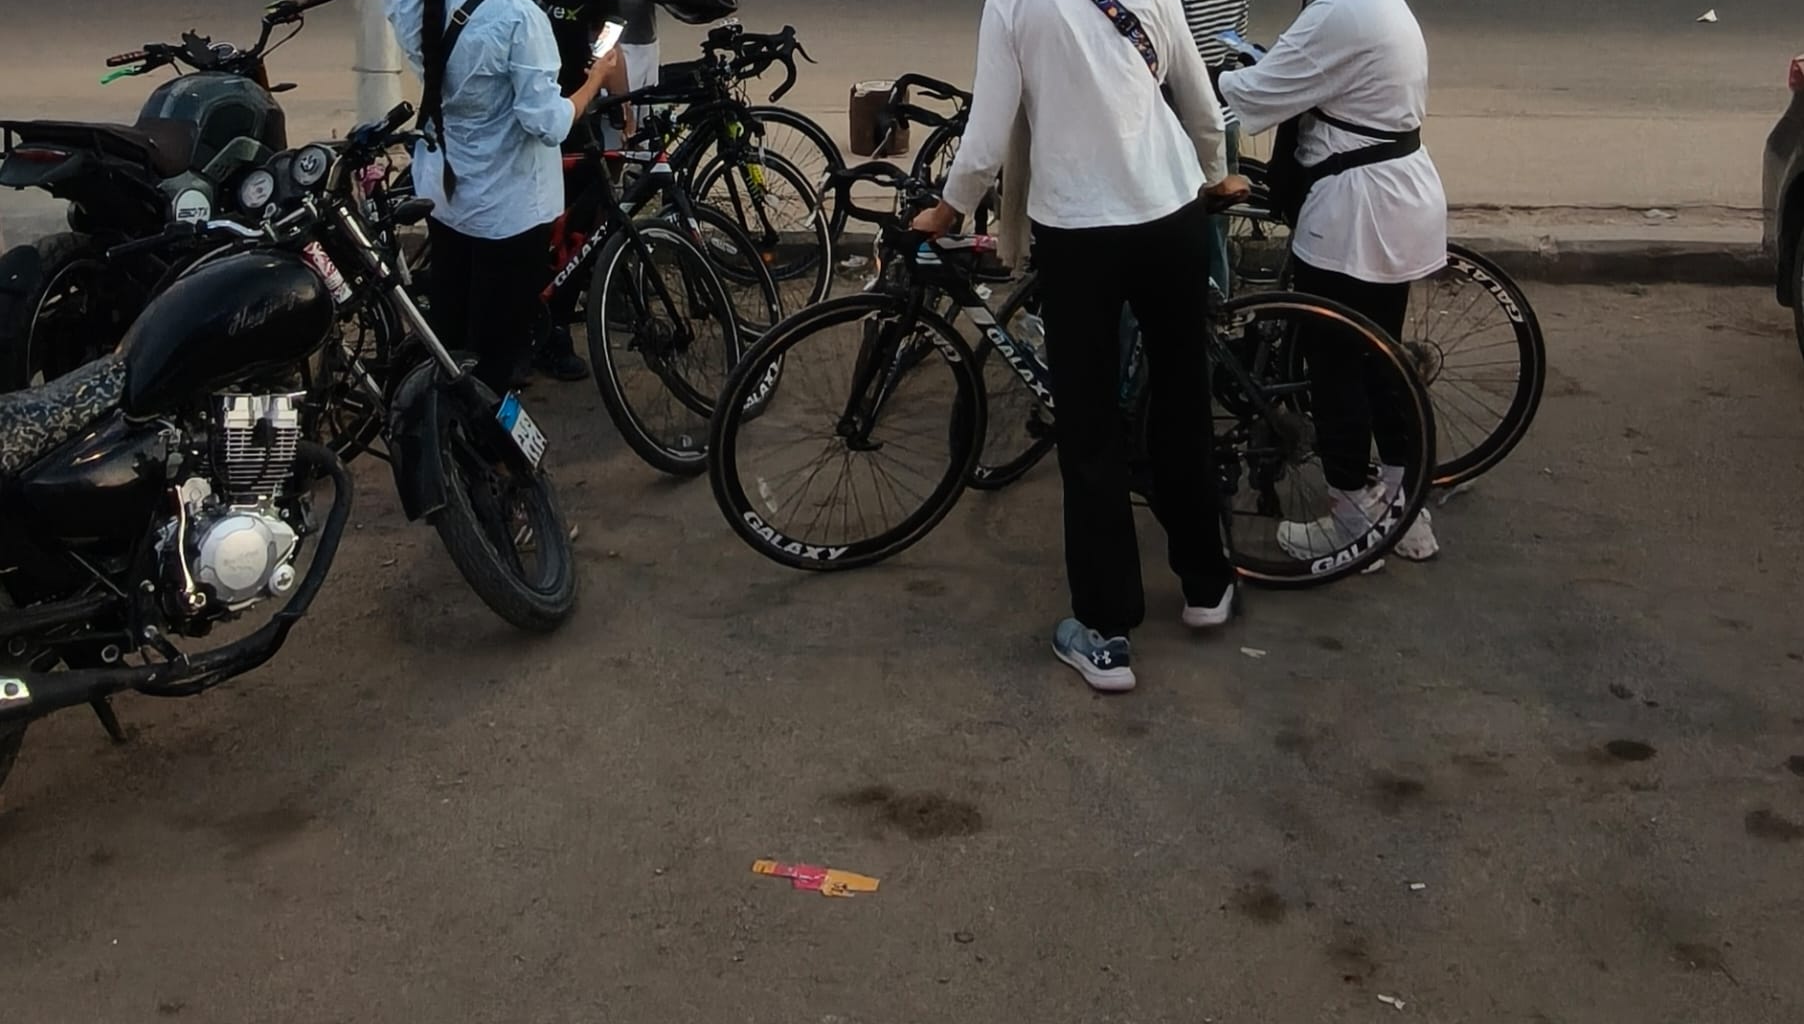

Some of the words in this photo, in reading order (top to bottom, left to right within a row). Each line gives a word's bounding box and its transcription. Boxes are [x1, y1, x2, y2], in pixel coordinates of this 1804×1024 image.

[553, 220, 608, 287] GALAXY
[1450, 260, 1524, 323] GALAX
[743, 510, 849, 561] GALAXY
[1310, 484, 1406, 574] GALAXY
